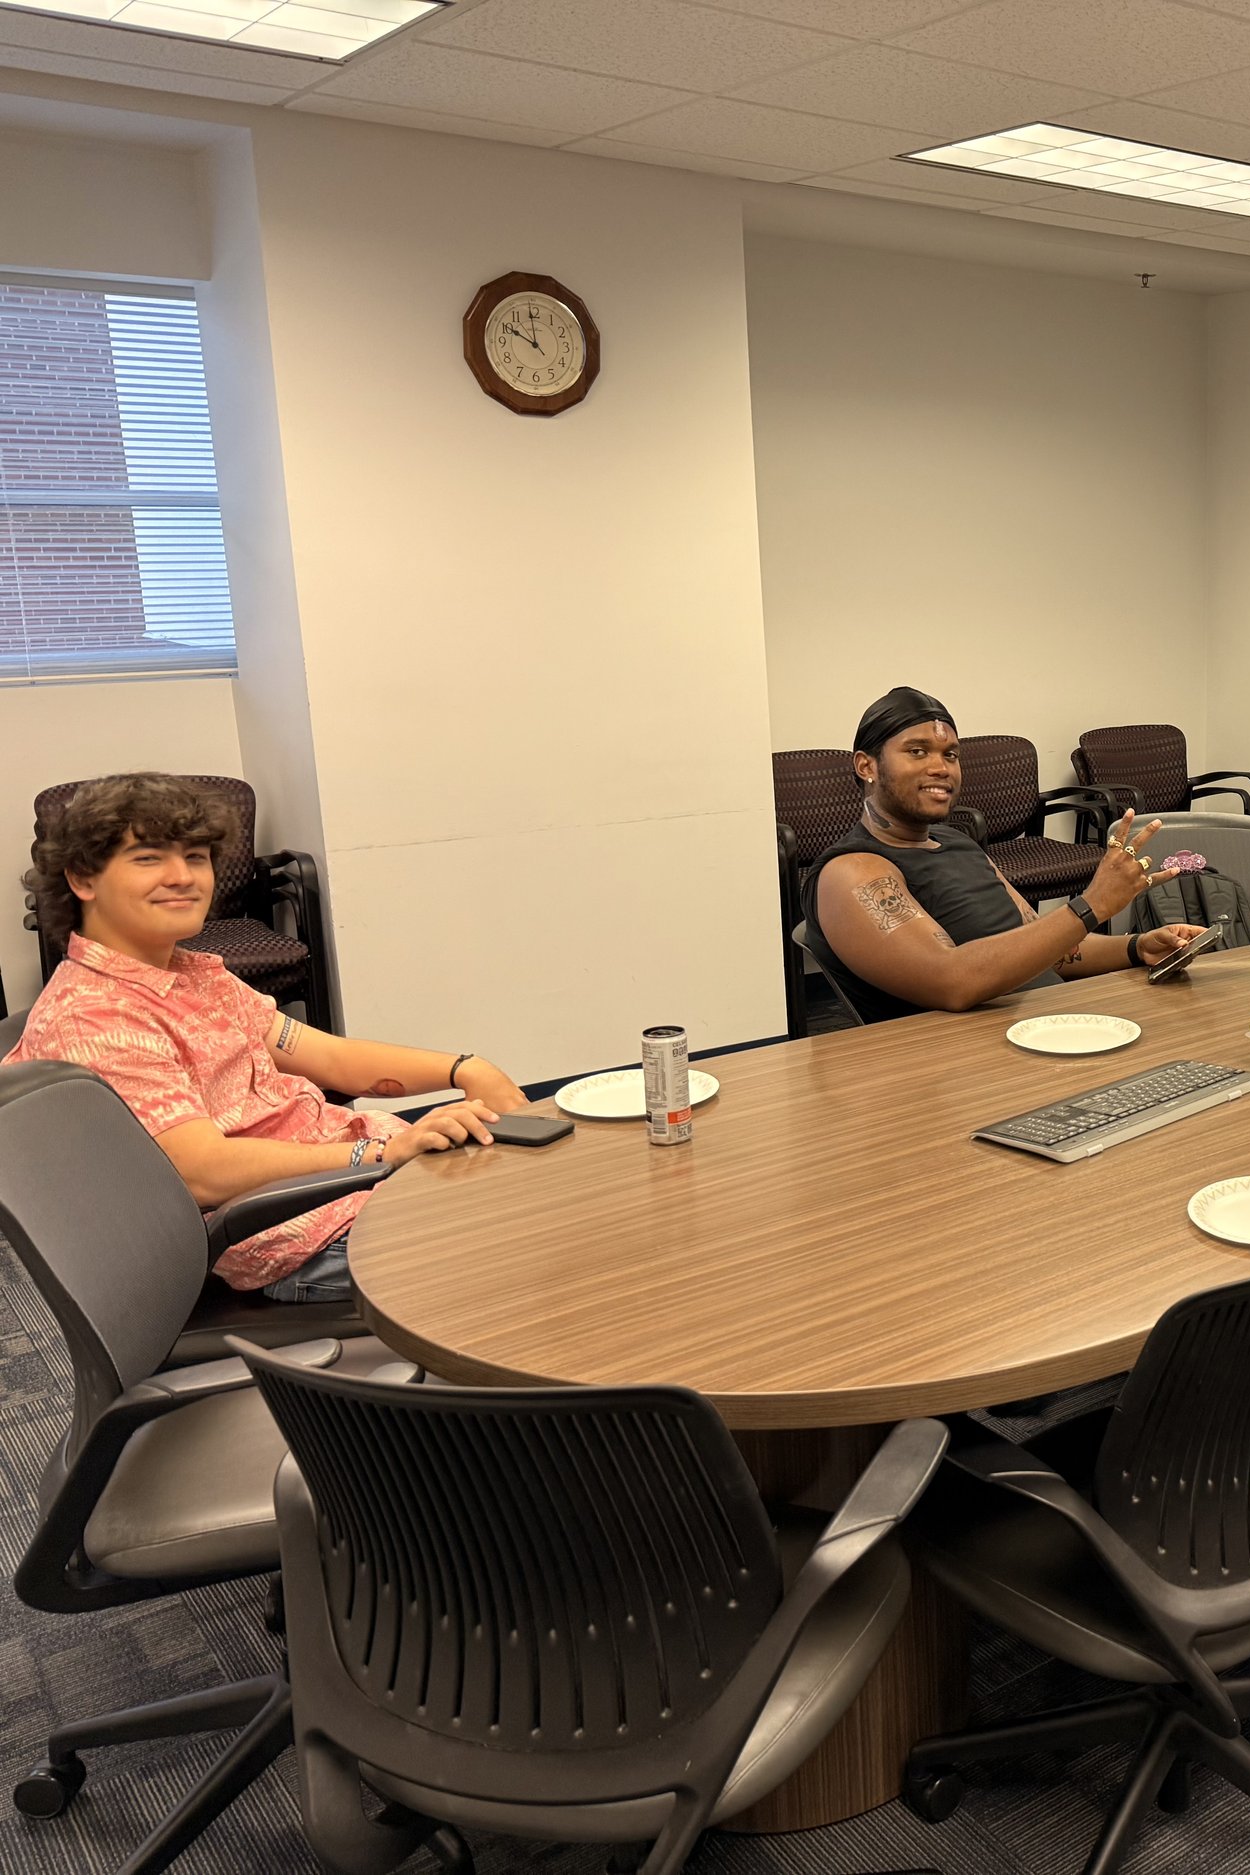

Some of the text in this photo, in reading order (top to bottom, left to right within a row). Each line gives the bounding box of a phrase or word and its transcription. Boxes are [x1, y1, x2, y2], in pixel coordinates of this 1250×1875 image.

[512, 311, 520, 322] 11
[549, 314, 554, 326] 1
[502, 322, 514, 335] 10
[557, 326, 566, 339] 2
[498, 336, 506, 348] 9
[562, 342, 570, 354] 3
[503, 352, 512, 364] 8
[557, 357, 566, 368] 4
[516, 366, 524, 378] 7
[532, 371, 540, 383] 6
[547, 368, 555, 380] 5
